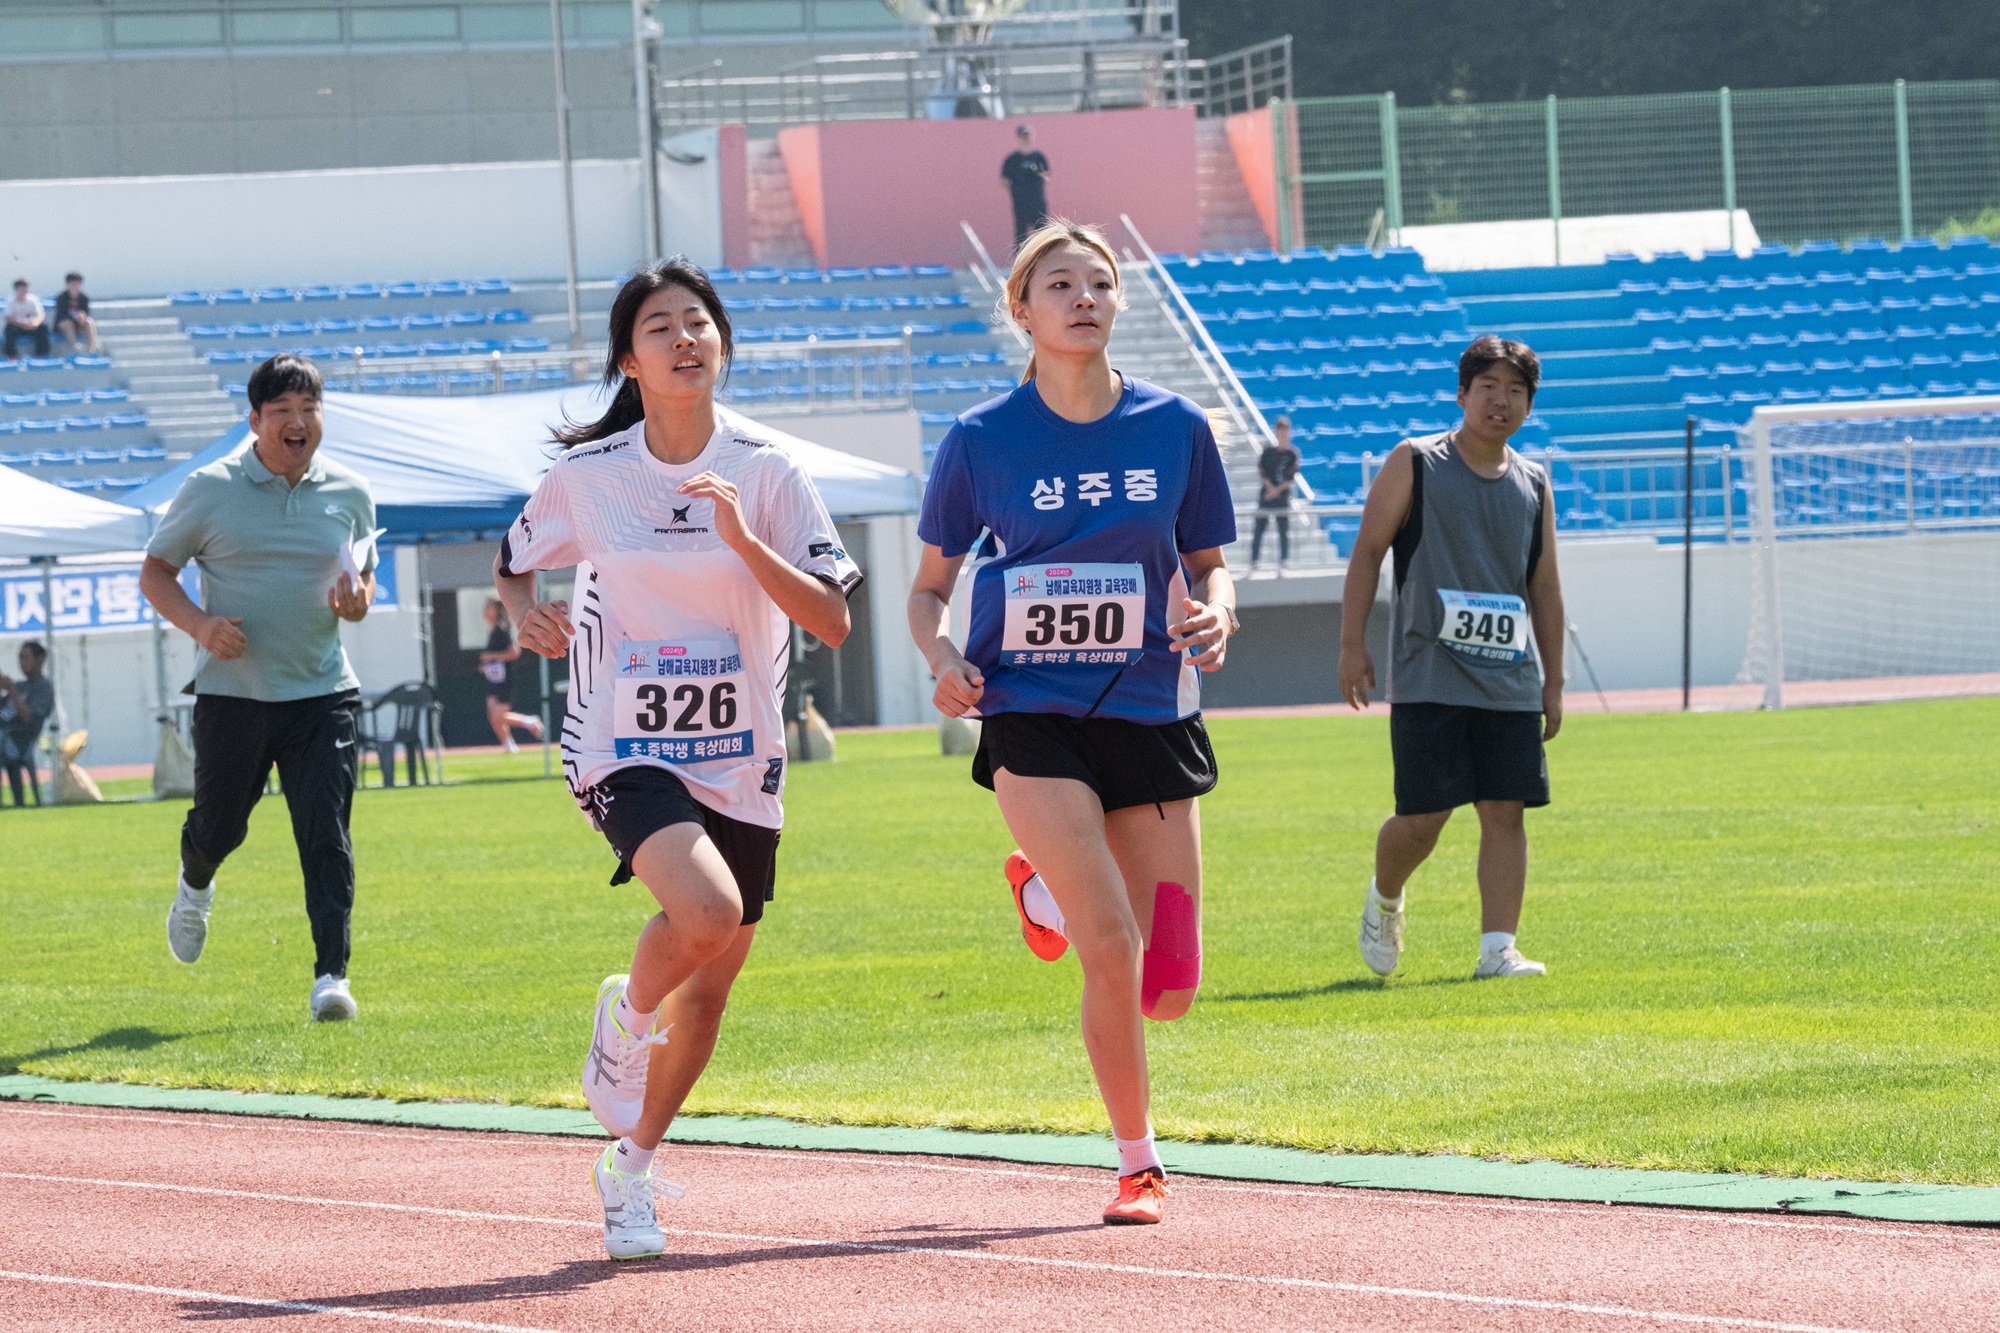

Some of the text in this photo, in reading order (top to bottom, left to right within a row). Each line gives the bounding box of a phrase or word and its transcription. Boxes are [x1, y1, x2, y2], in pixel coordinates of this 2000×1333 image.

[1049, 569, 1070, 577] 2024년
[1045, 577, 1137, 596] 남해교육지원청 교육장배
[1025, 602, 1124, 646] 350
[1454, 610, 1514, 645] 349
[658, 659, 717, 675] 남해교육지원청
[1014, 652, 1127, 664] 초·중학생 육상대회
[636, 682, 737, 732] 326
[694, 736, 743, 757] 육상대회
